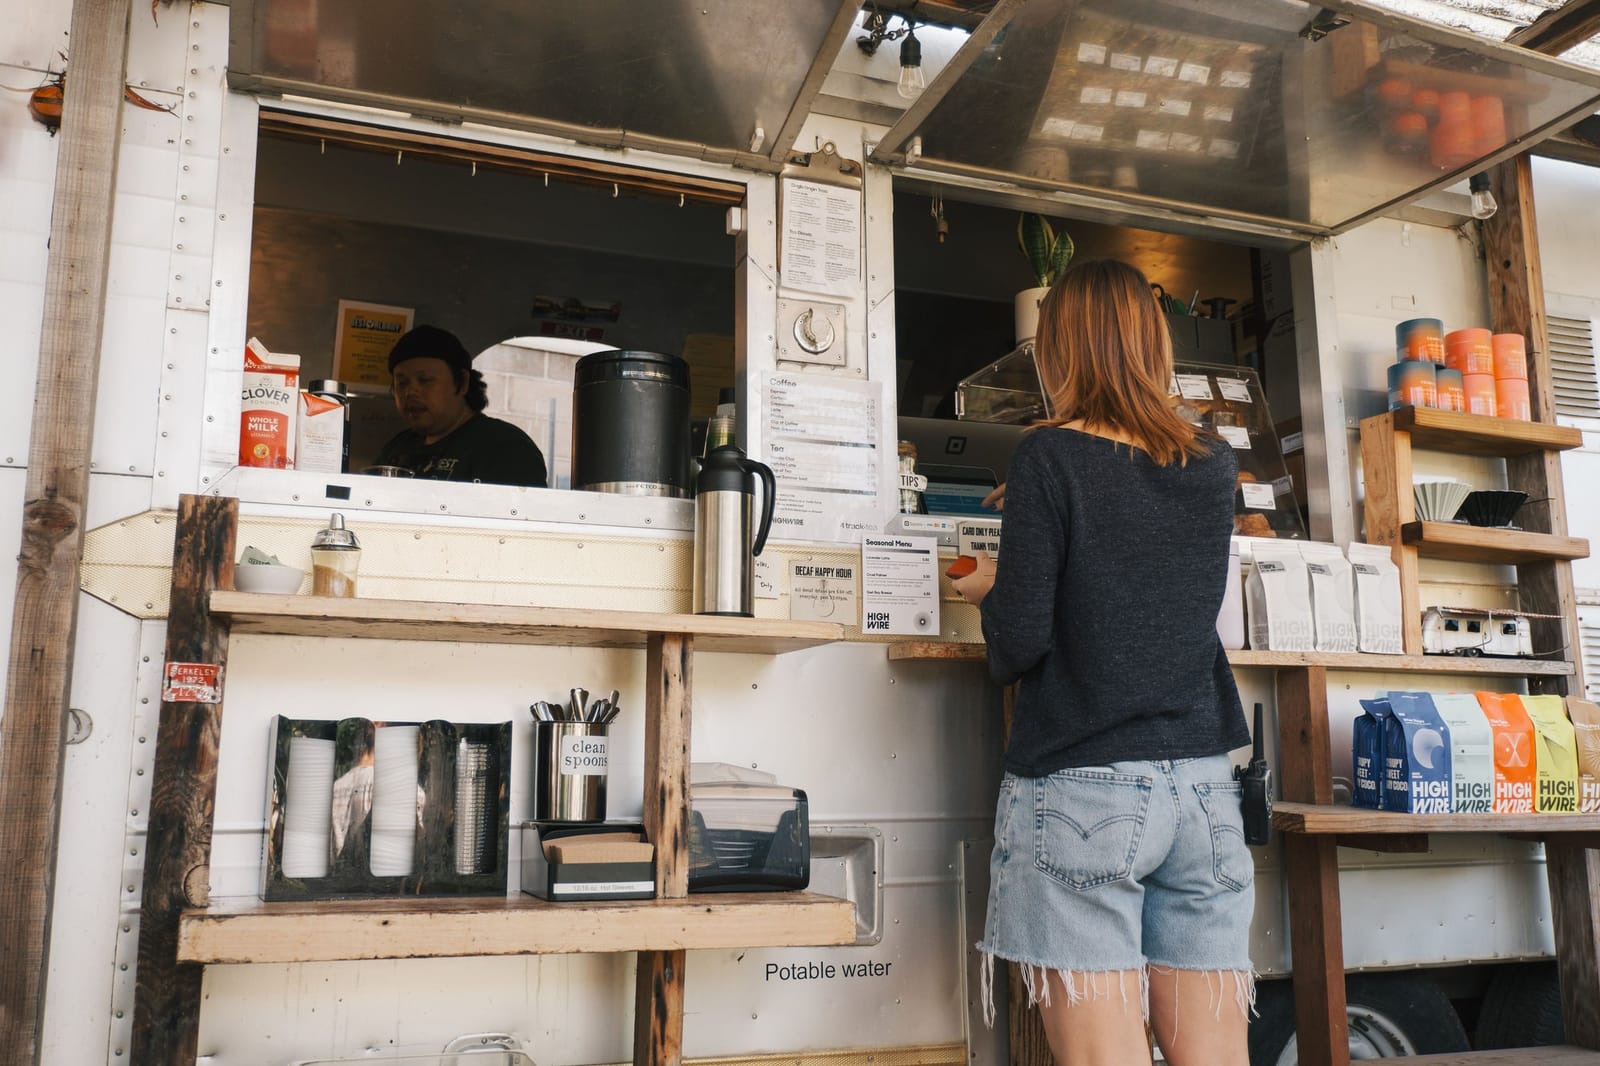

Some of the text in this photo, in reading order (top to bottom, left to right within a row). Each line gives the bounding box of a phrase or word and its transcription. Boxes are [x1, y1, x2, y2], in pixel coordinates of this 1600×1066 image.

[769, 377, 798, 388] Coffee
[242, 388, 290, 404] CLOVER
[248, 416, 279, 424] WHOLE
[248, 423, 279, 432] MILK
[769, 443, 785, 453] Tea
[900, 475, 919, 488] TIPS
[988, 528, 1001, 537] PLEA
[865, 538, 913, 549] Seasonal Menu
[795, 565, 852, 579] DECAF HAPPY HOUR
[867, 611, 890, 621] HIGH
[867, 621, 890, 630] WIRE
[1273, 621, 1311, 637] HIGH
[1321, 622, 1355, 638] HIGH
[1365, 623, 1400, 639] HIGH
[1273, 637, 1311, 650] WIRE
[1321, 638, 1355, 652] WIRE
[1365, 640, 1400, 653] WIRE
[182, 675, 206, 684] 1972
[572, 740, 606, 754] clean
[564, 755, 608, 769] spoons
[1412, 781, 1449, 798] HIGH
[1455, 783, 1491, 798] HIGH
[1496, 782, 1532, 798] HIGH
[1539, 780, 1575, 796] HIGH
[1582, 782, 1600, 798] HI
[1412, 798, 1450, 814] WIRE
[1455, 799, 1492, 813] WIRE
[1496, 799, 1532, 813] WIRE
[1539, 797, 1575, 812] WIRE
[765, 960, 892, 981] Potable water
